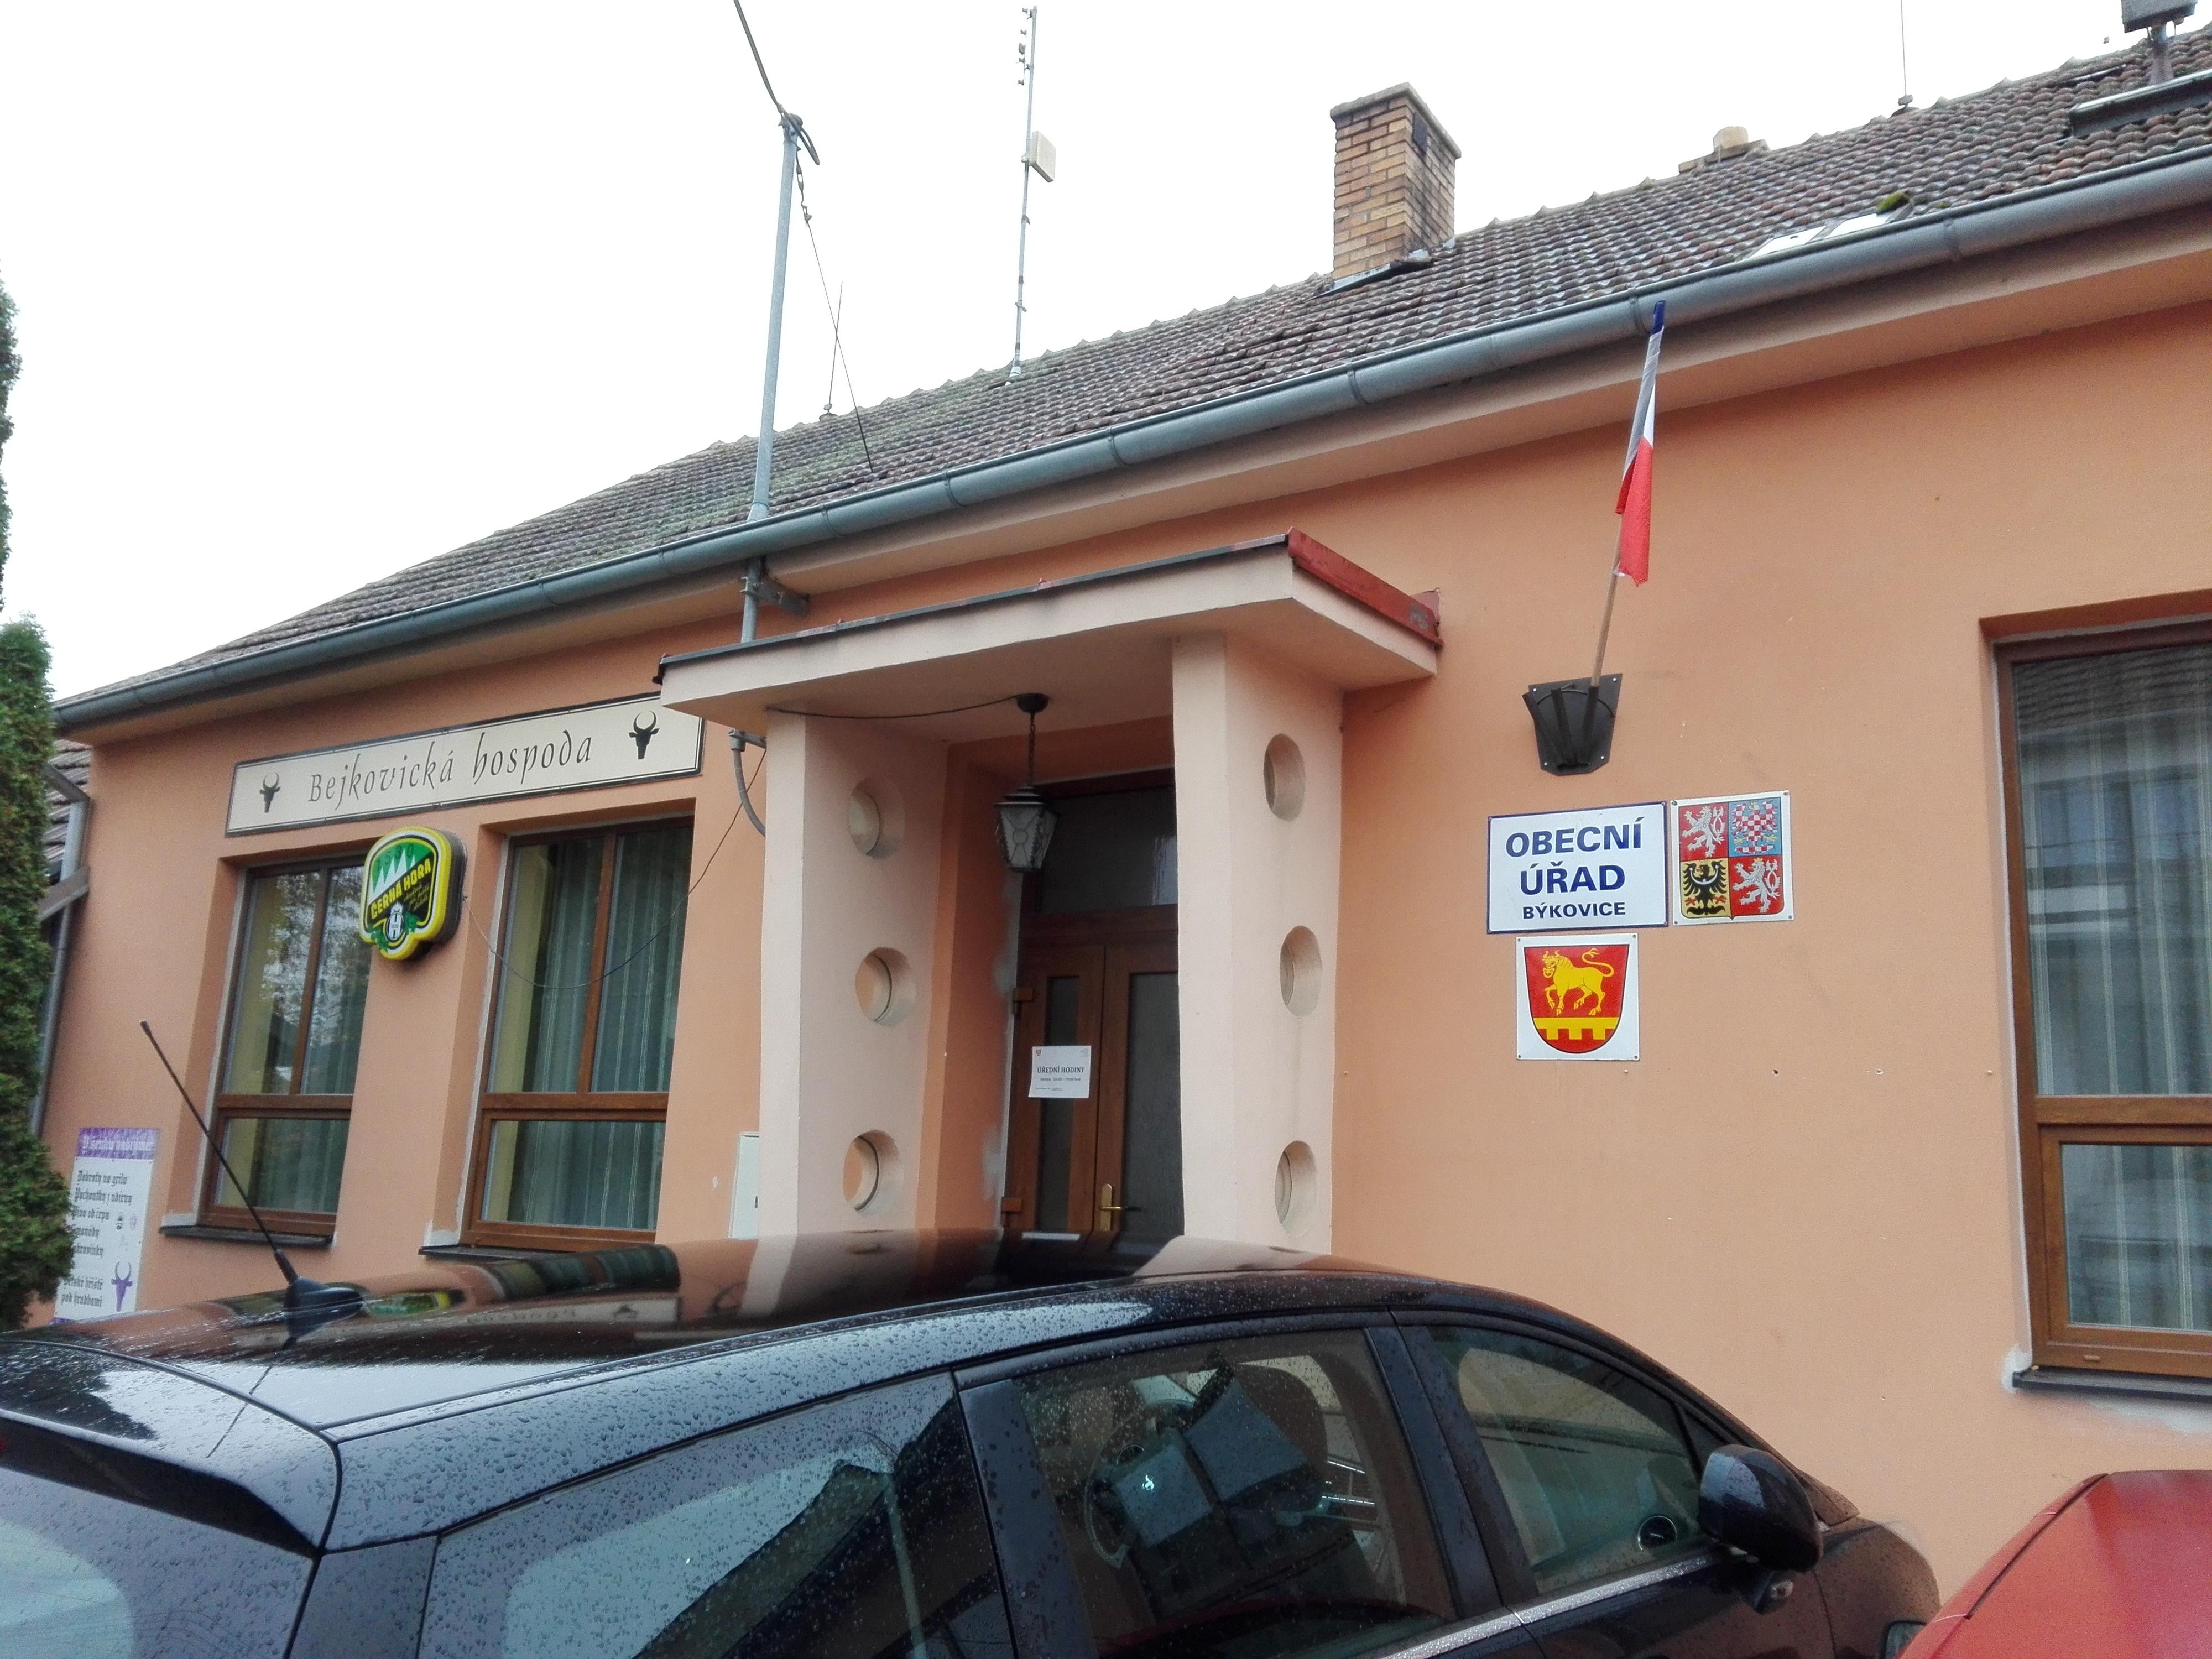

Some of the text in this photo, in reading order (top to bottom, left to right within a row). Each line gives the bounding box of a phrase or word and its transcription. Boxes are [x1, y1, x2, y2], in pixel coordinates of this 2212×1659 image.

[307, 729, 592, 811] Bejkovická hospoda
[1505, 816, 1645, 858] OBECNÍ
[403, 858, 431, 891] HORA
[1519, 860, 1626, 896] ÚŘAD
[1522, 902, 1626, 920] BÝKOVICE
[77, 1170, 102, 1185] Dobroty
[111, 1173, 127, 1187] grilu
